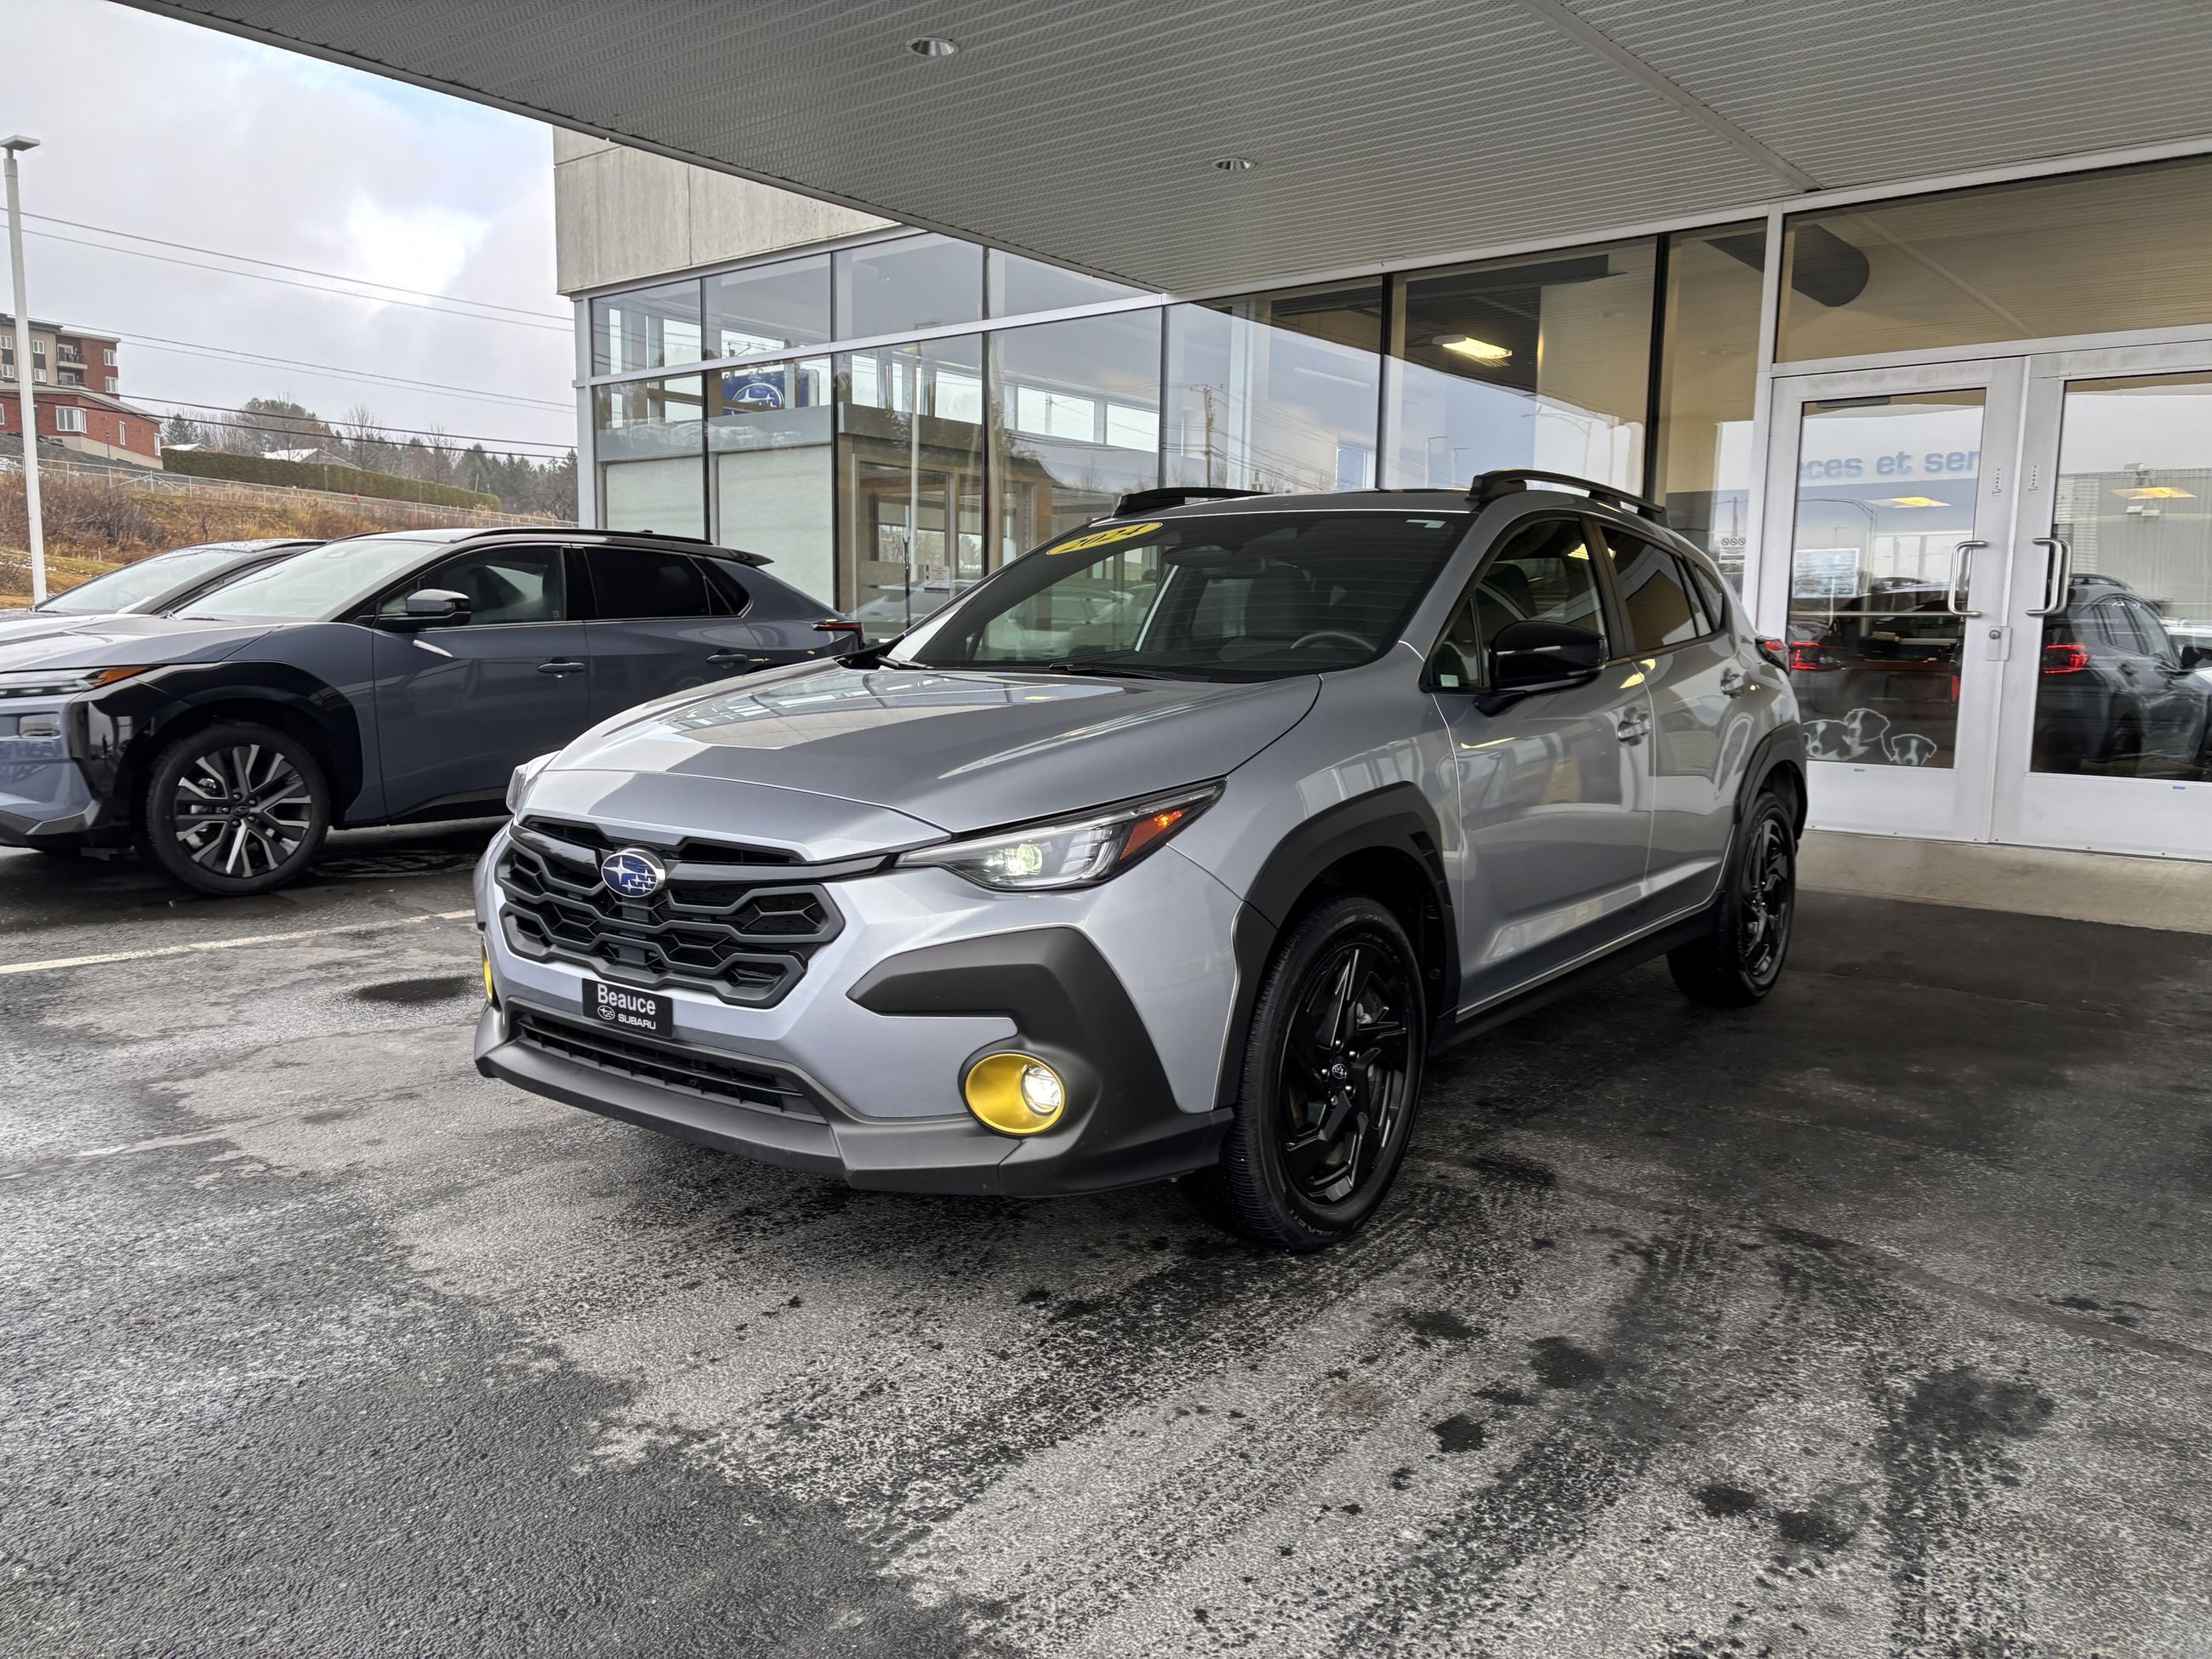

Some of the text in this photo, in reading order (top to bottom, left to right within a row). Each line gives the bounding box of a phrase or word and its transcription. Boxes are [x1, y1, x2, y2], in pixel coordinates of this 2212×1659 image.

[1801, 457, 1863, 479] ces
[1876, 450, 1913, 476] et
[597, 983, 657, 1016] Beauce
[618, 1013, 657, 1030] SUBARU
